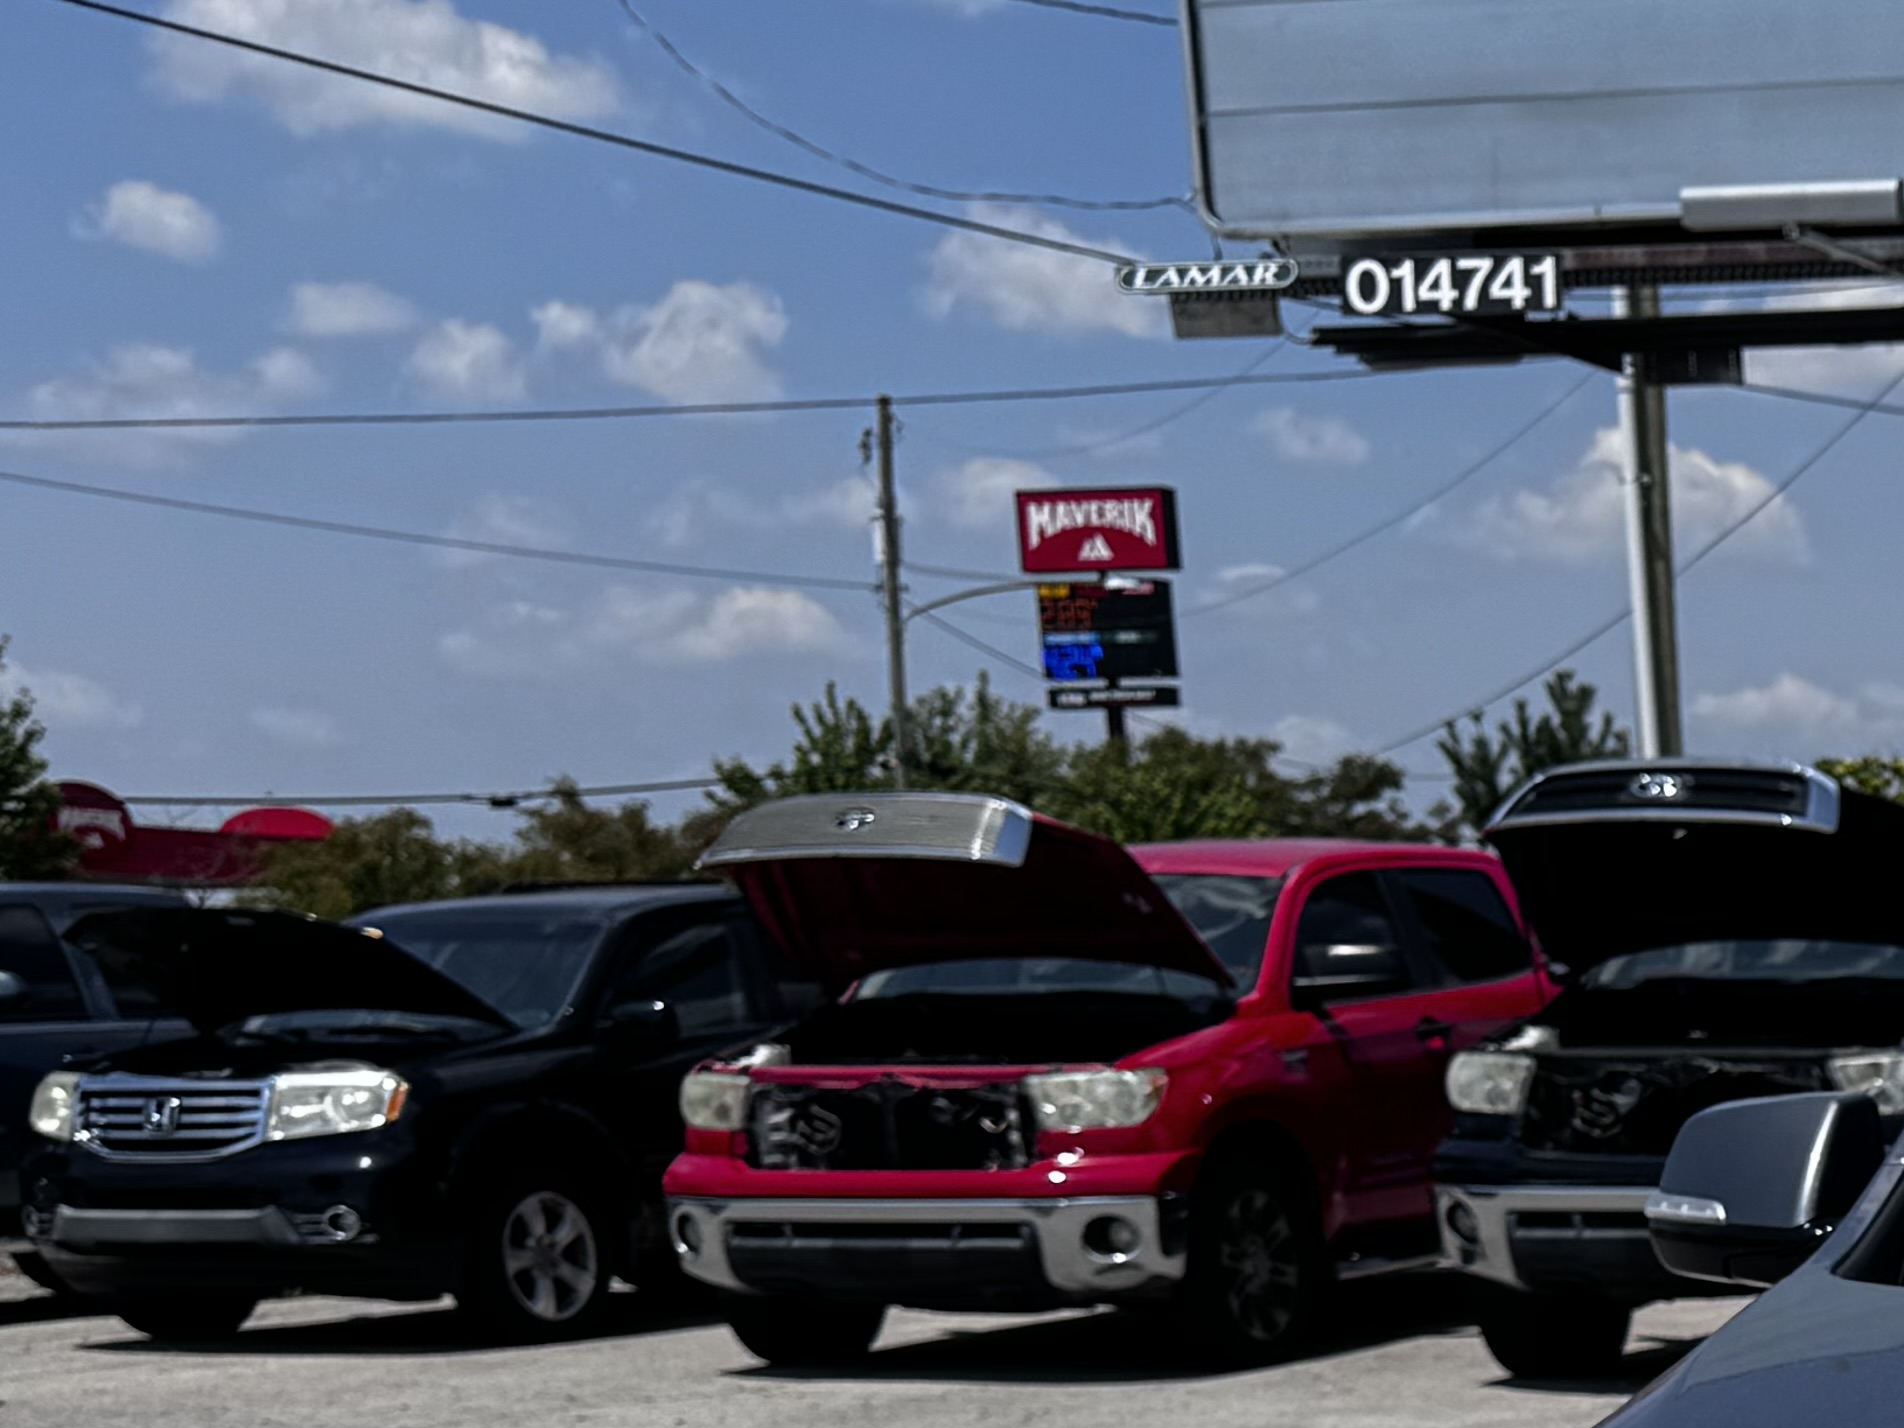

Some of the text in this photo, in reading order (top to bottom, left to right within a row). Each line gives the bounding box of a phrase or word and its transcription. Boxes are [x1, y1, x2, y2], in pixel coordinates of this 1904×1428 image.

[1132, 262, 1280, 289] LAMAR
[1345, 255, 1557, 314] 014741
[1027, 498, 1157, 551] MAVERIK
